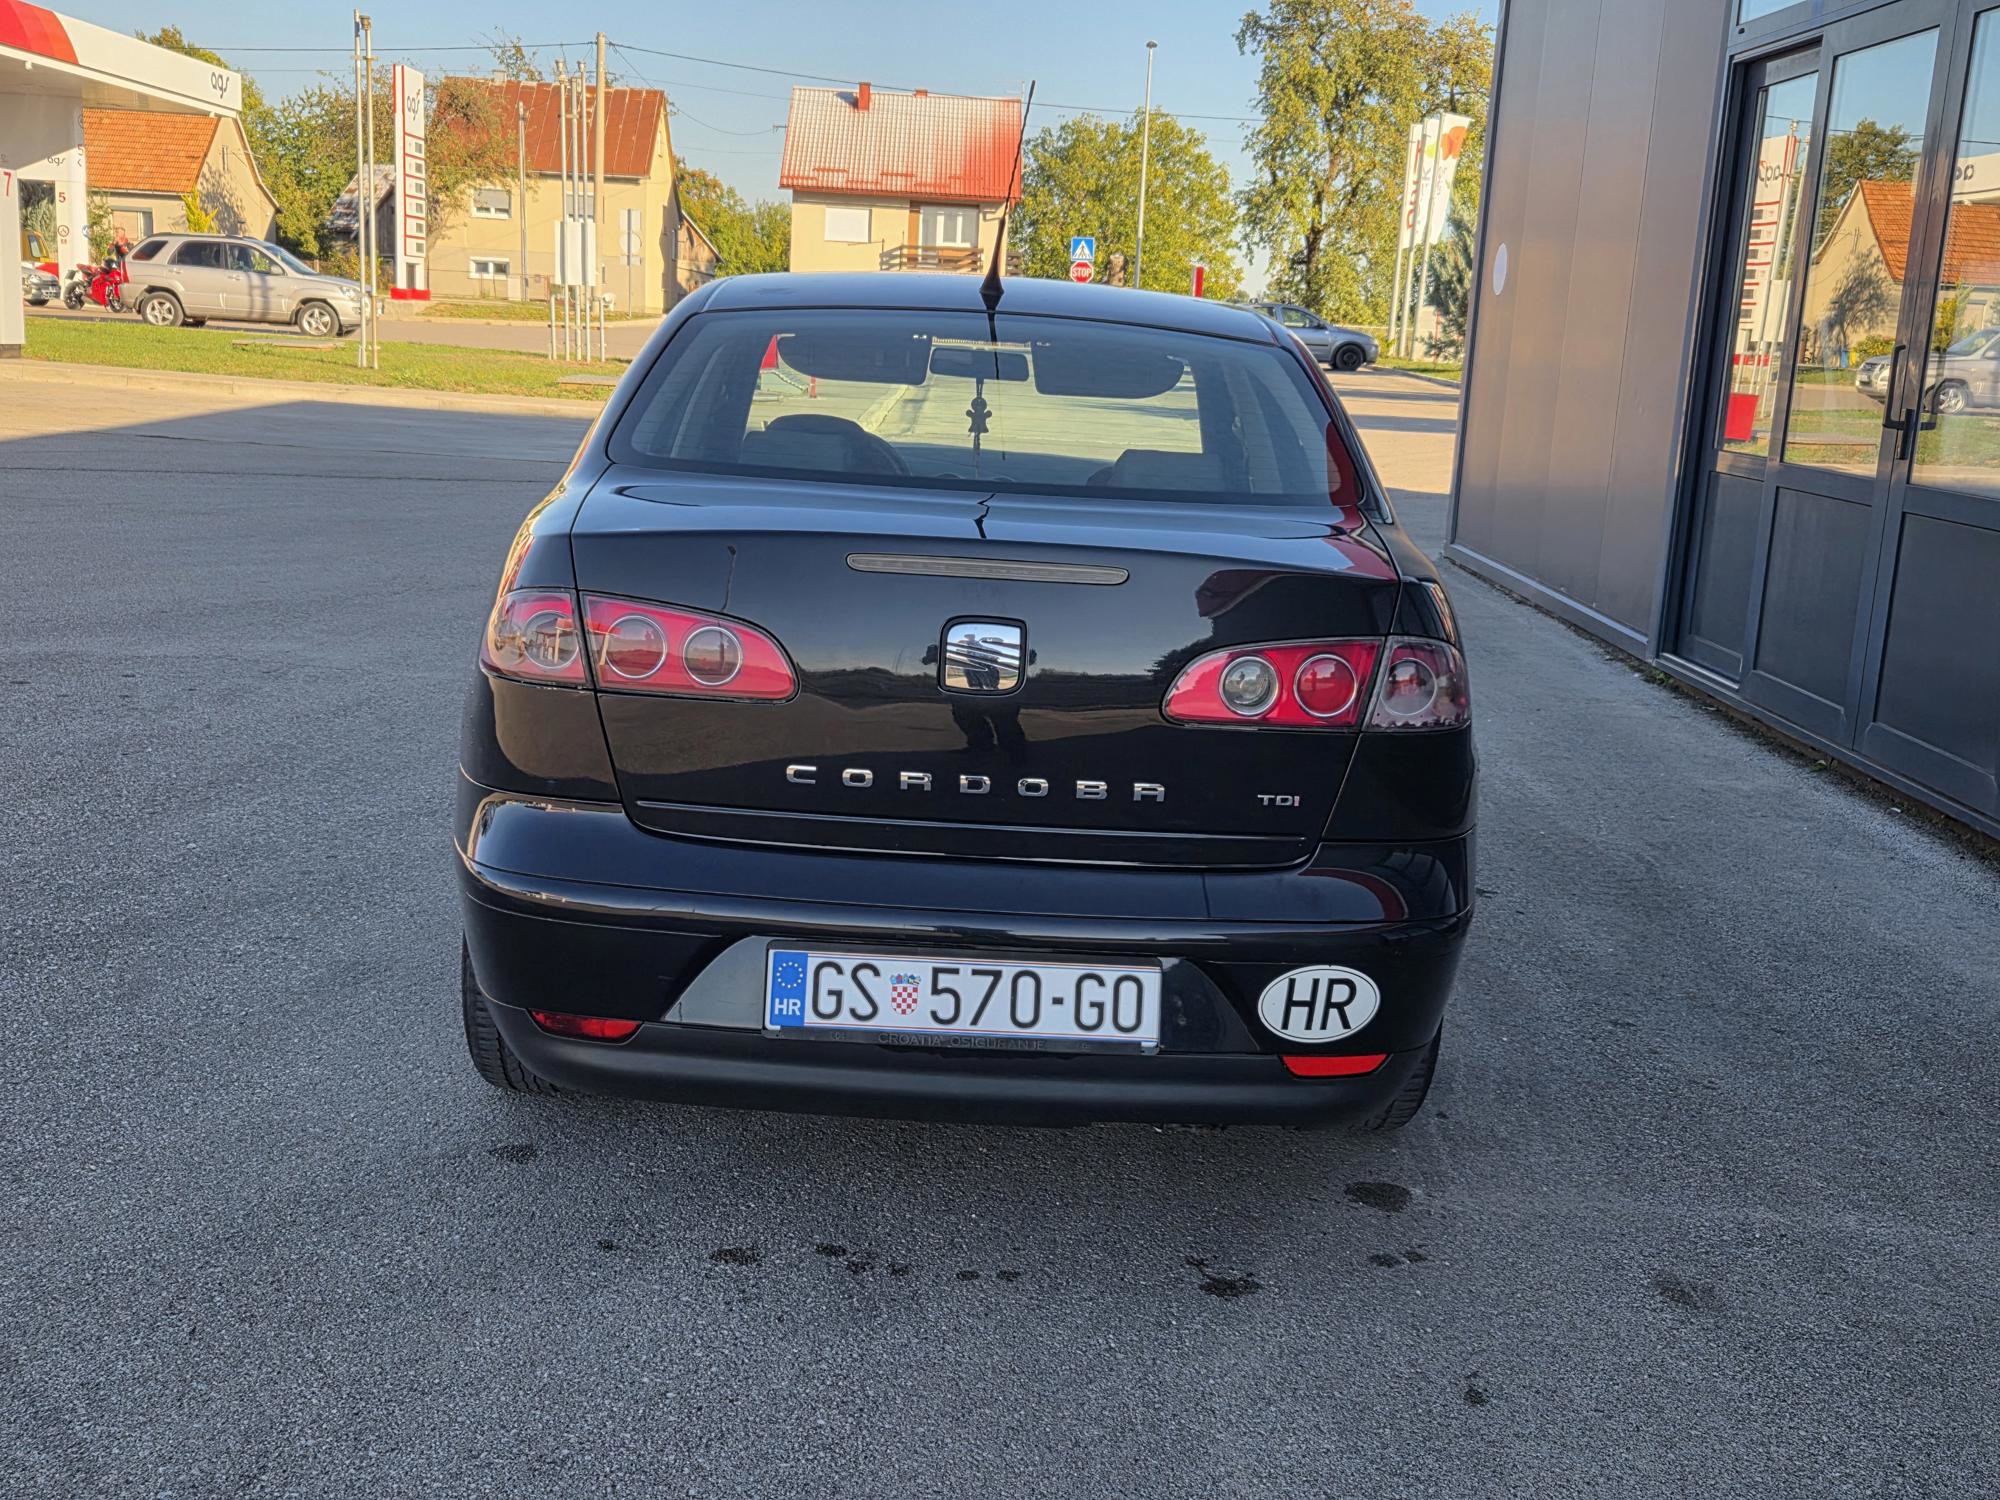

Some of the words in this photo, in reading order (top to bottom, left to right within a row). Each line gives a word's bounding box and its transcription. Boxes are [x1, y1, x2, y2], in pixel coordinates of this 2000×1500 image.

[58, 191, 67, 203] 5
[1071, 267, 1092, 278] STOP
[785, 764, 1166, 802] CORDOBA
[1257, 793, 1301, 808] TDI
[811, 960, 881, 1022] GS
[930, 966, 1144, 1034] 570-GO
[1280, 977, 1357, 1031] HR
[773, 997, 801, 1016] HR
[878, 1032, 944, 1046] CROATIA
[950, 1035, 1045, 1050] OSIGURANJE
